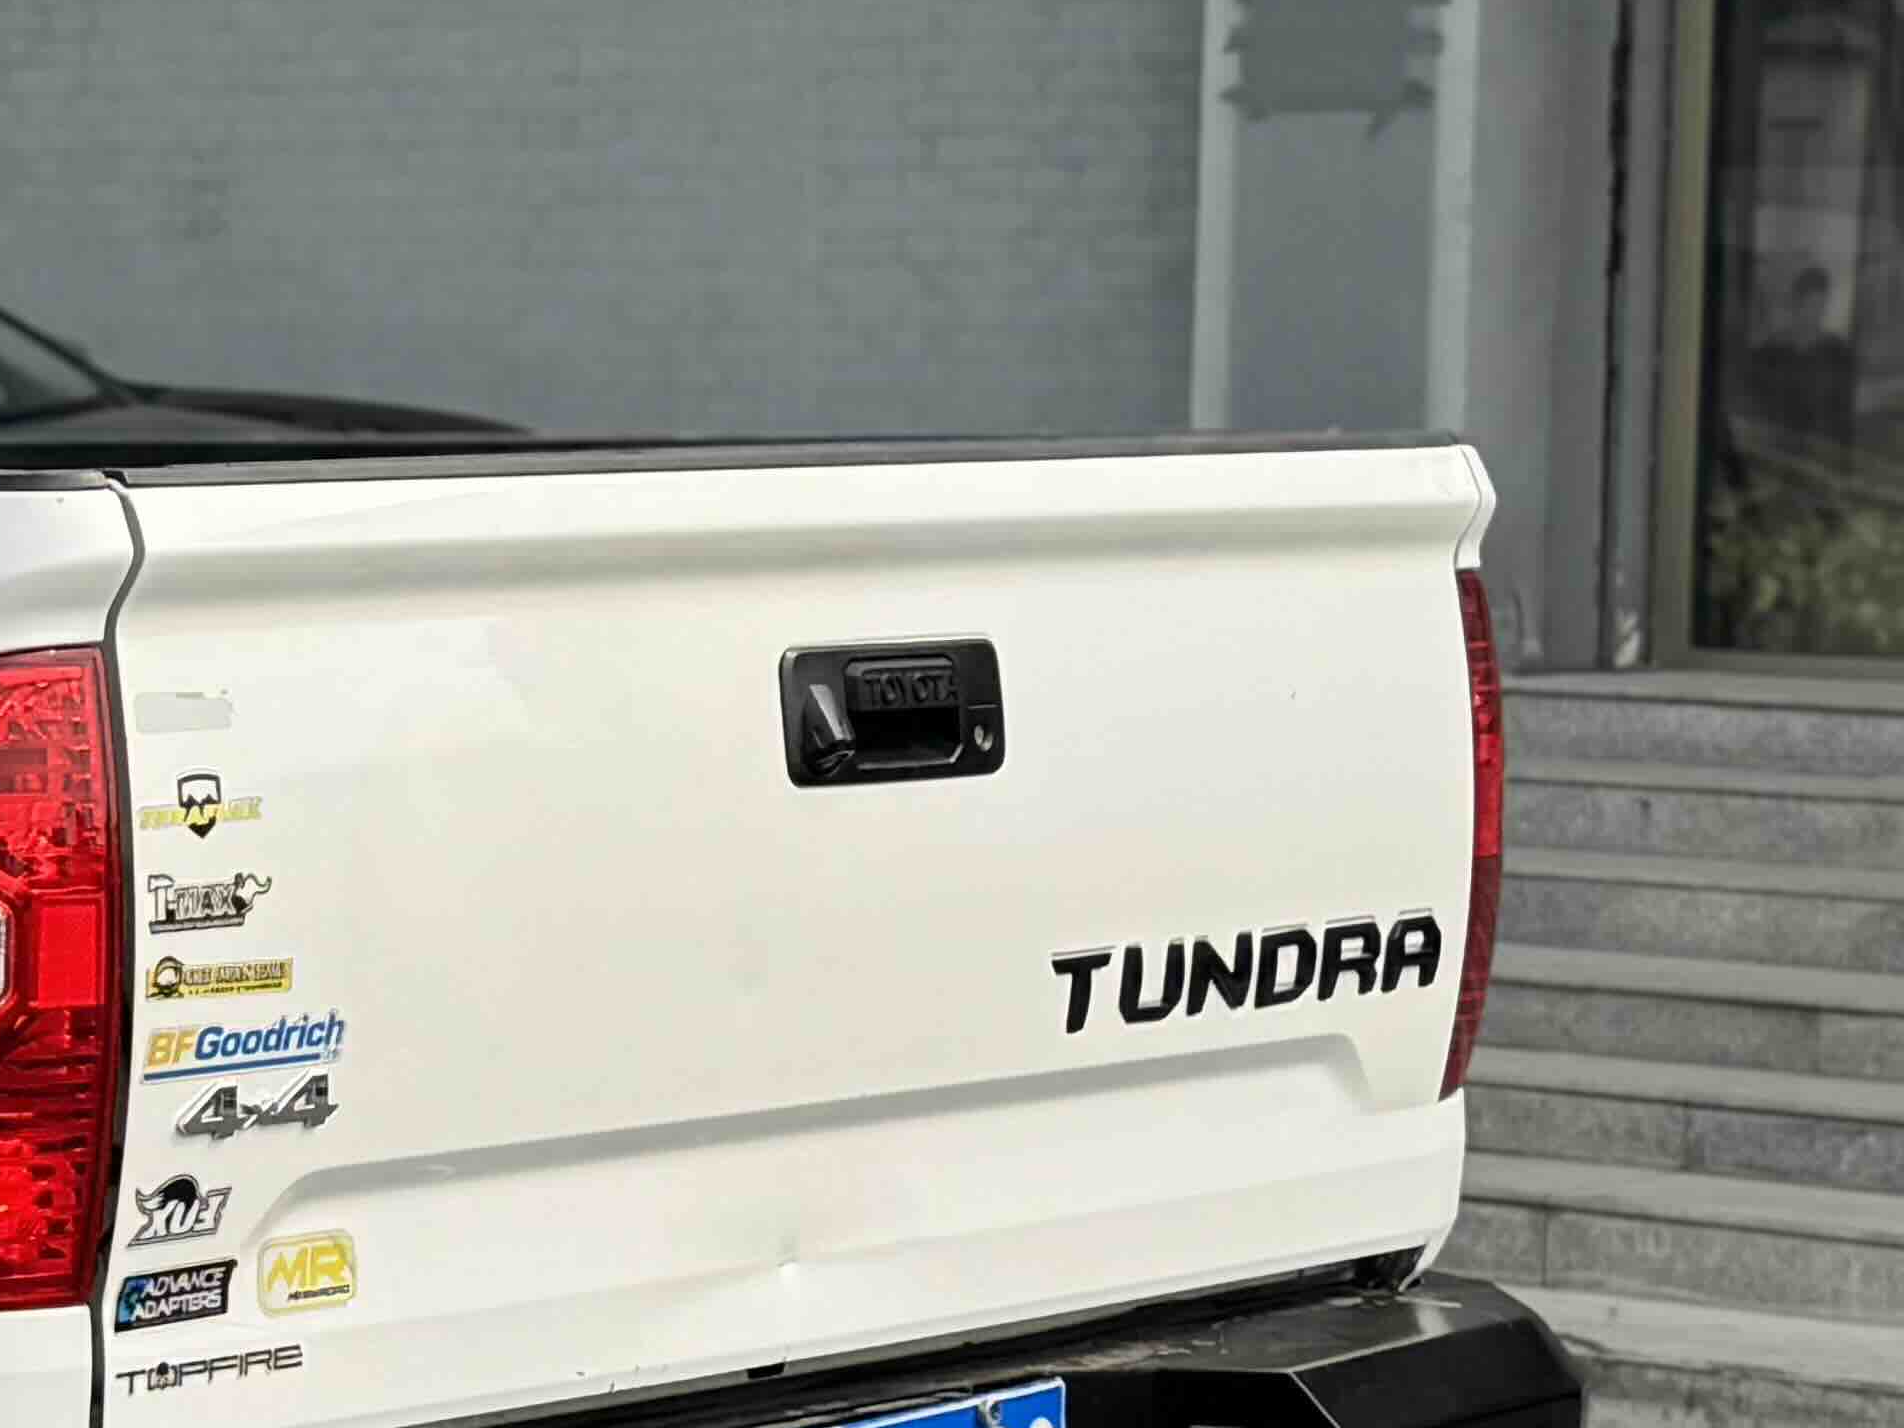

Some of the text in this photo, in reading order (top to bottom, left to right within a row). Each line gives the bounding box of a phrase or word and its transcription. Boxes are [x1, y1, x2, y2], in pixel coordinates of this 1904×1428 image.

[1050, 907, 1442, 1034] TUNDRA
[147, 1010, 345, 1068] BFGoodrich
[130, 1288, 222, 1322] ADAPTERS
[140, 1267, 227, 1299] ADVANCE
